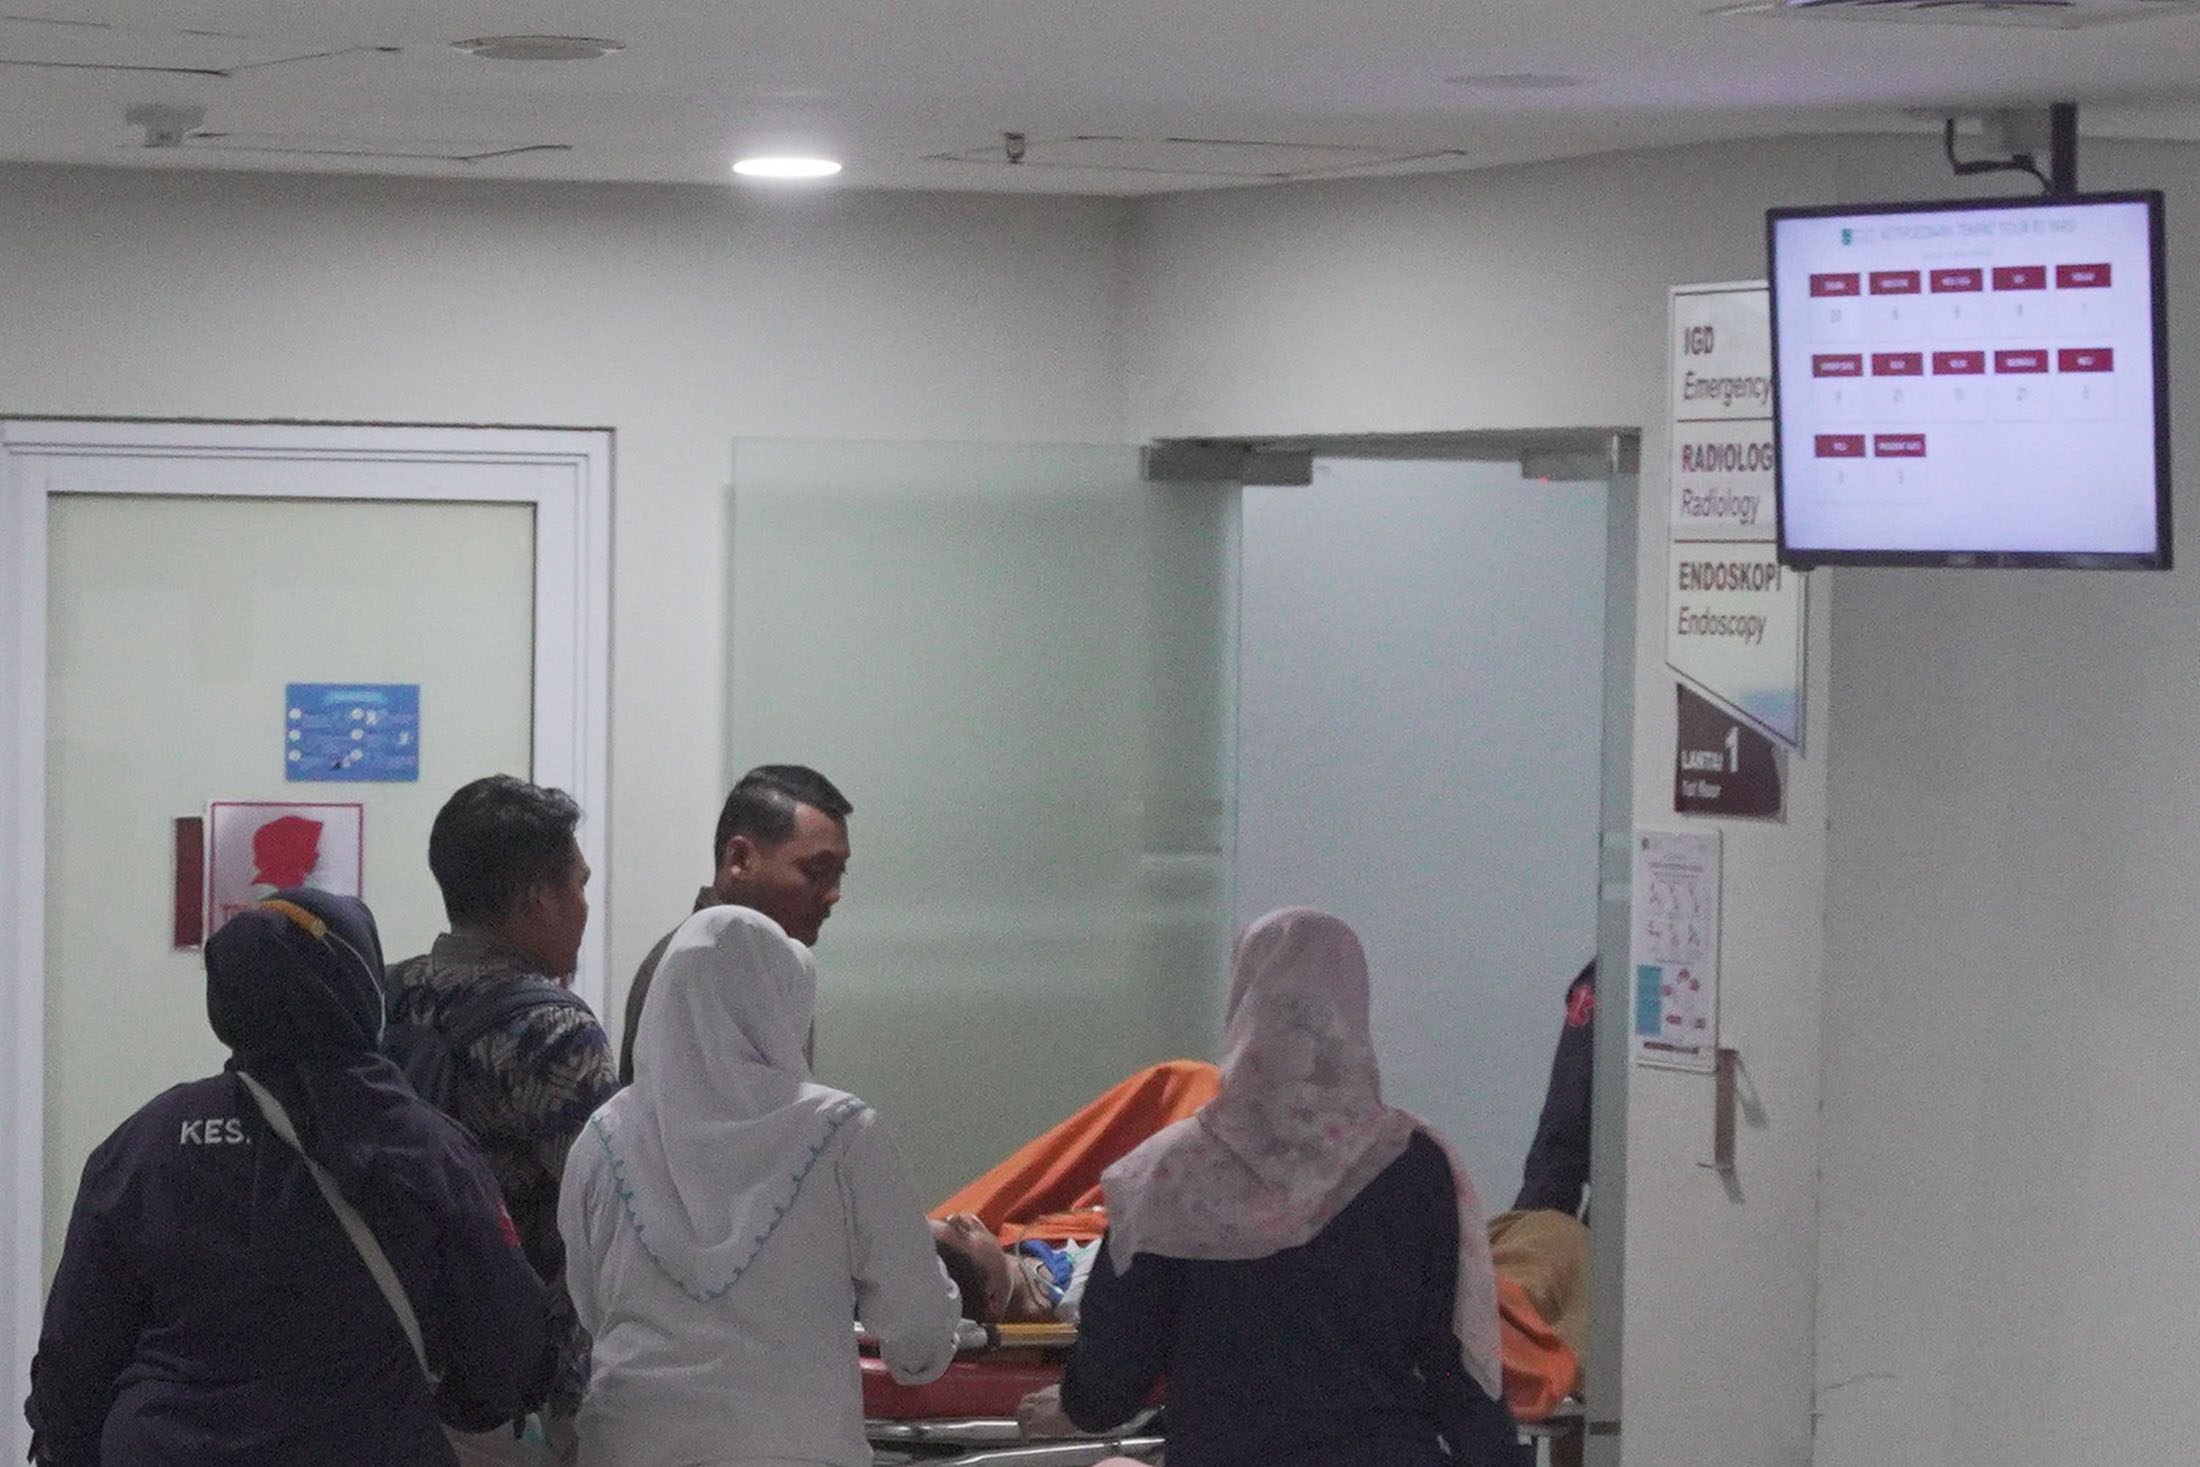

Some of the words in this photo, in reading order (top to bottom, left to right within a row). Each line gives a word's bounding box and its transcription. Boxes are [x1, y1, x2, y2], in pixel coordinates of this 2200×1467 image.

[1684, 326, 1715, 355] IGD
[1684, 371, 1770, 407] Emergency
[1682, 443, 1773, 472] RADIOLOG
[1681, 488, 1760, 524] Radiology
[1679, 561, 1781, 591] ENDOSKOPI
[1678, 606, 1766, 644] Endoscopy
[1724, 726, 1739, 773] 1
[180, 1118, 250, 1145] KES.
